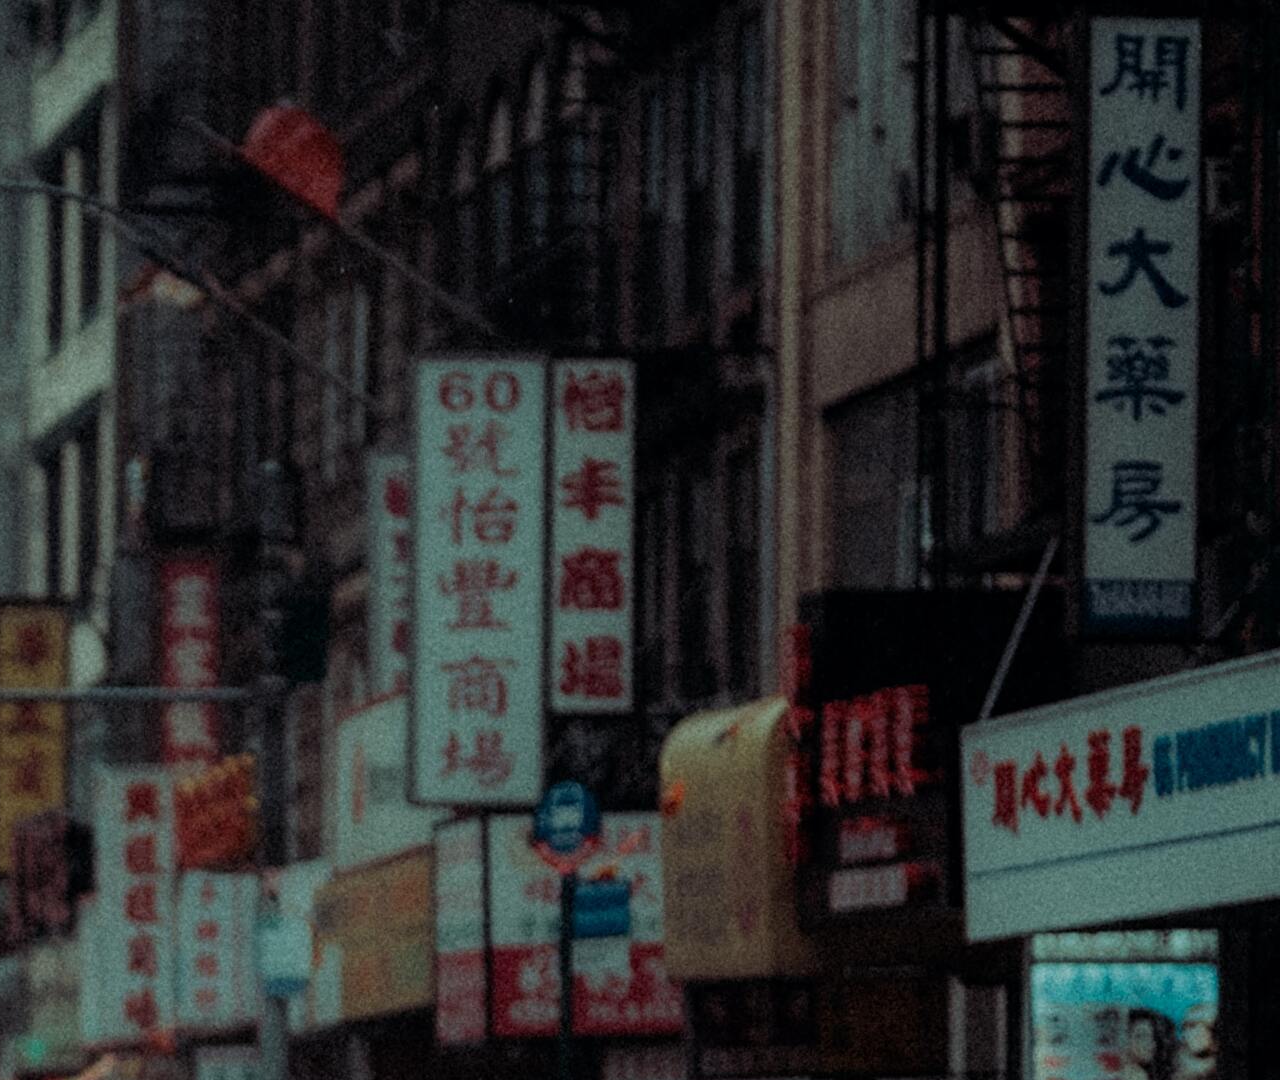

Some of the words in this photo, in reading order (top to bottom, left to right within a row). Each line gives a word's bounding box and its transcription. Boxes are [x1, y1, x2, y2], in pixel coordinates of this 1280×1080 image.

[1090, 32, 1192, 544] 開心大藥房
[992, 724, 1149, 836] 開心大藥房
